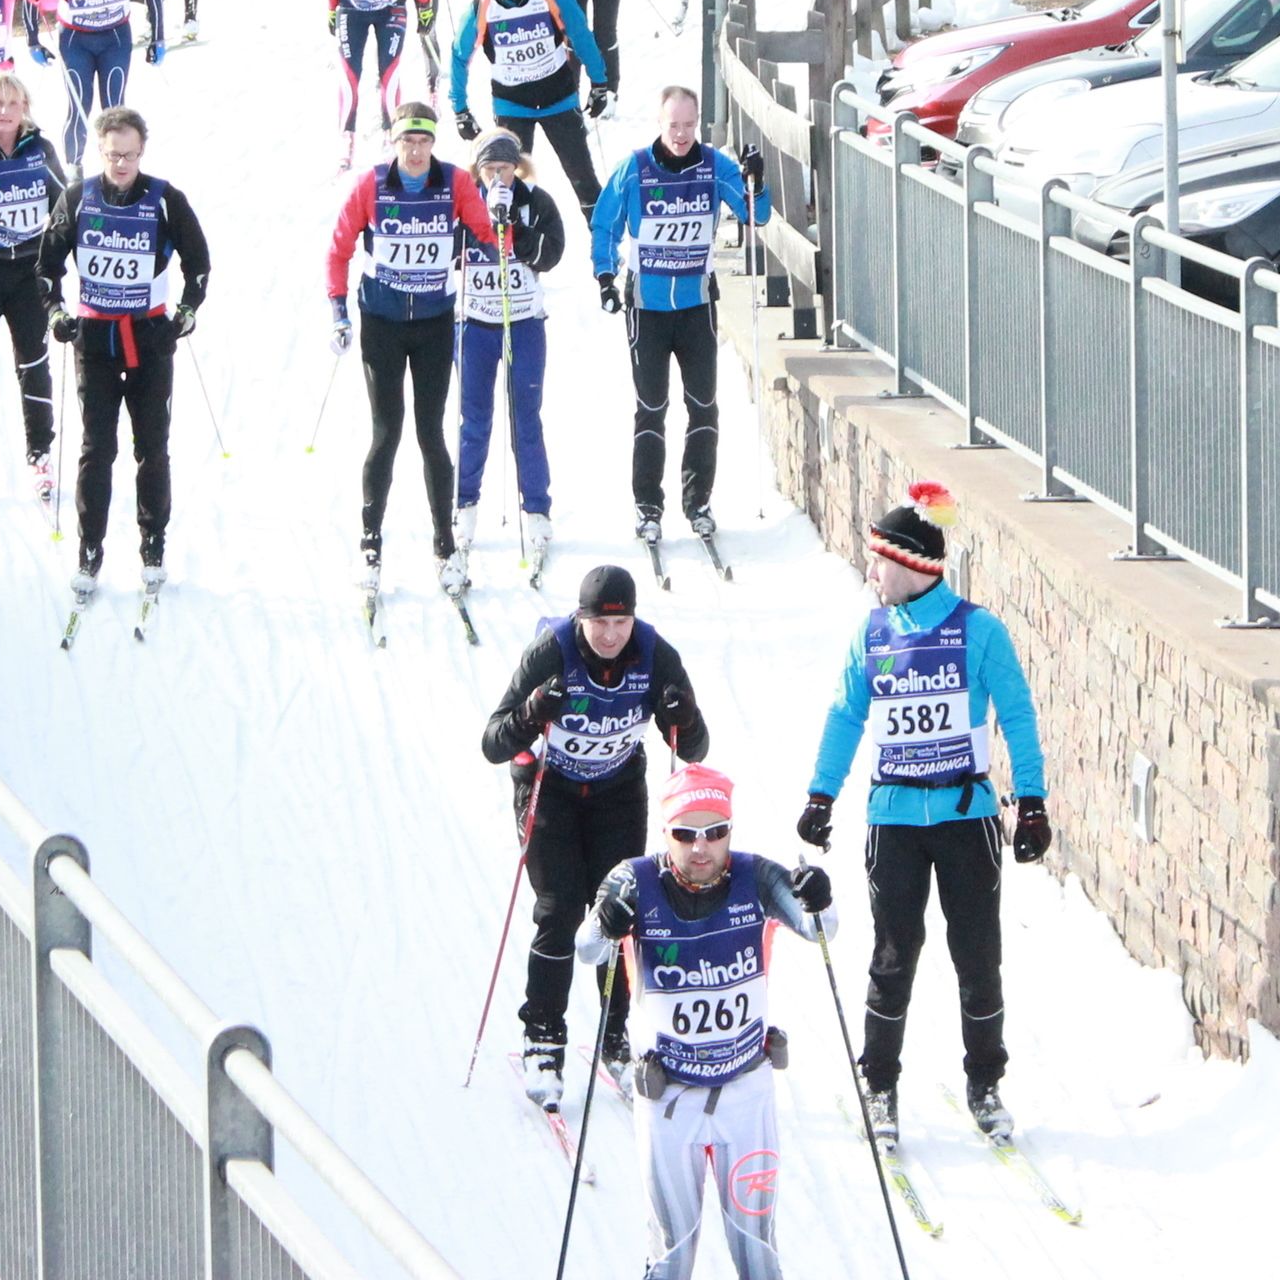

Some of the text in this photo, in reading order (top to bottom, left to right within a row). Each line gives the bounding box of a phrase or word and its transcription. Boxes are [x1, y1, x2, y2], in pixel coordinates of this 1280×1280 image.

[494, 23, 550, 45] Melinda
[341, 43, 352, 59] SKI
[506, 41, 546, 63] 5808
[646, 194, 710, 215] Melinda
[381, 215, 448, 234] Melinda
[653, 221, 702, 242] 7272
[82, 230, 151, 251] Melinda
[388, 242, 439, 265] 7129
[88, 255, 139, 280] 6763
[949, 638, 962, 646] KM
[637, 682, 650, 690] KM
[872, 664, 961, 695] Melinda
[561, 706, 643, 735] Melinda
[887, 702, 952, 736] 5582
[564, 733, 633, 756] 6755
[881, 755, 971, 777] 43 MARCIALONGA
[730, 913, 757, 926] 70 KM
[645, 928, 671, 938] coop
[653, 949, 758, 988] Melinda
[672, 993, 752, 1035] 6262
[661, 1056, 677, 1070] 43
[678, 1043, 761, 1078] MARCIALONGA
